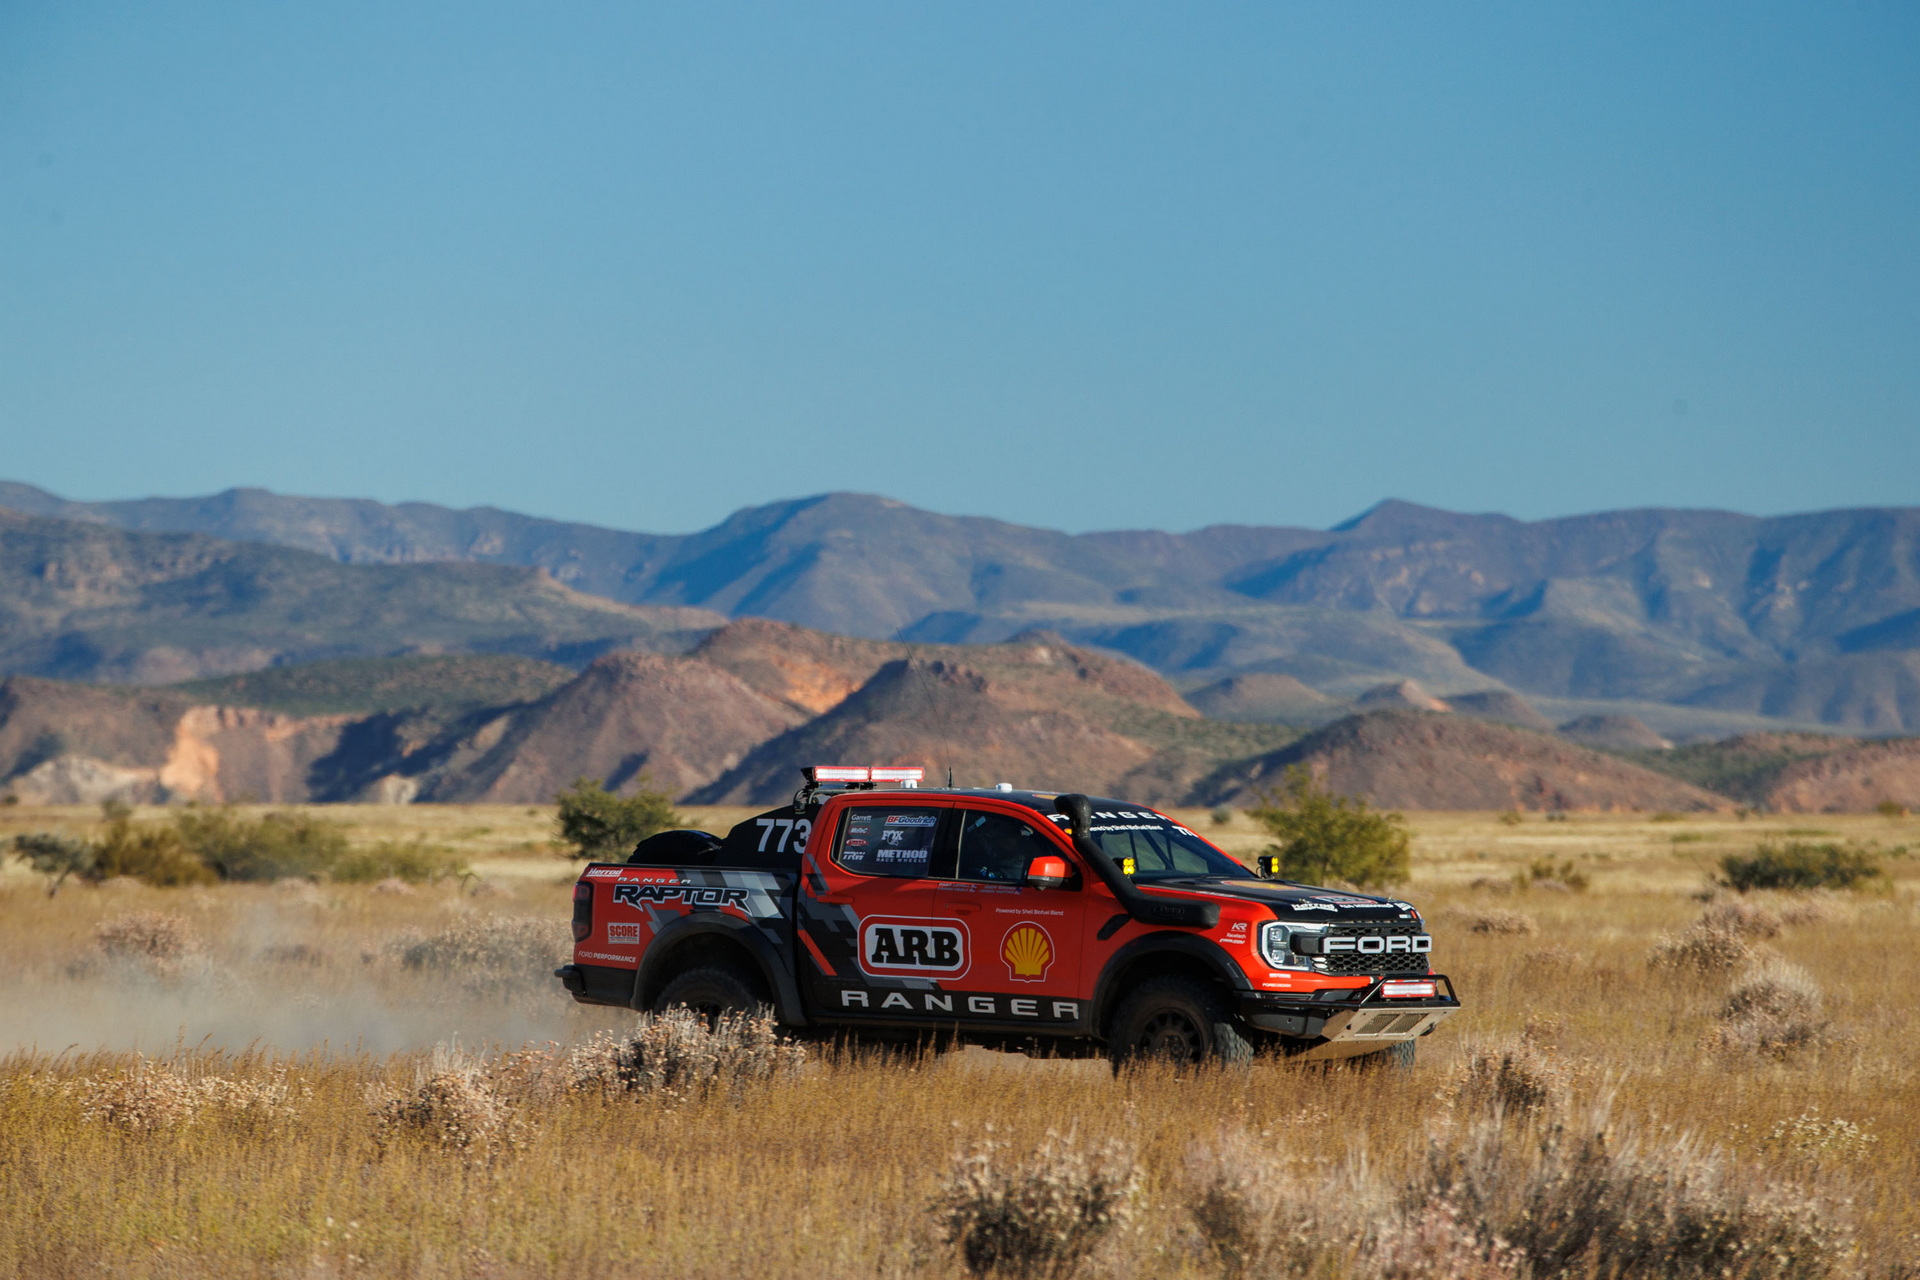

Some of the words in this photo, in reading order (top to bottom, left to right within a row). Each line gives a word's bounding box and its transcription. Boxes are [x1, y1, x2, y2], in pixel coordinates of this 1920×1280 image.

[886, 815, 936, 824] BFGoodrich
[756, 818, 811, 854] 773
[881, 830, 903, 842] FOX
[842, 851, 866, 860] TRW
[877, 850, 928, 858] METHOD
[613, 884, 752, 916] RAPTOR
[610, 925, 638, 937] SCORE
[872, 927, 960, 967] ARB
[1323, 935, 1432, 953] FORD
[593, 952, 636, 963] PERFORMANCE
[841, 990, 1079, 1020] RANGER
